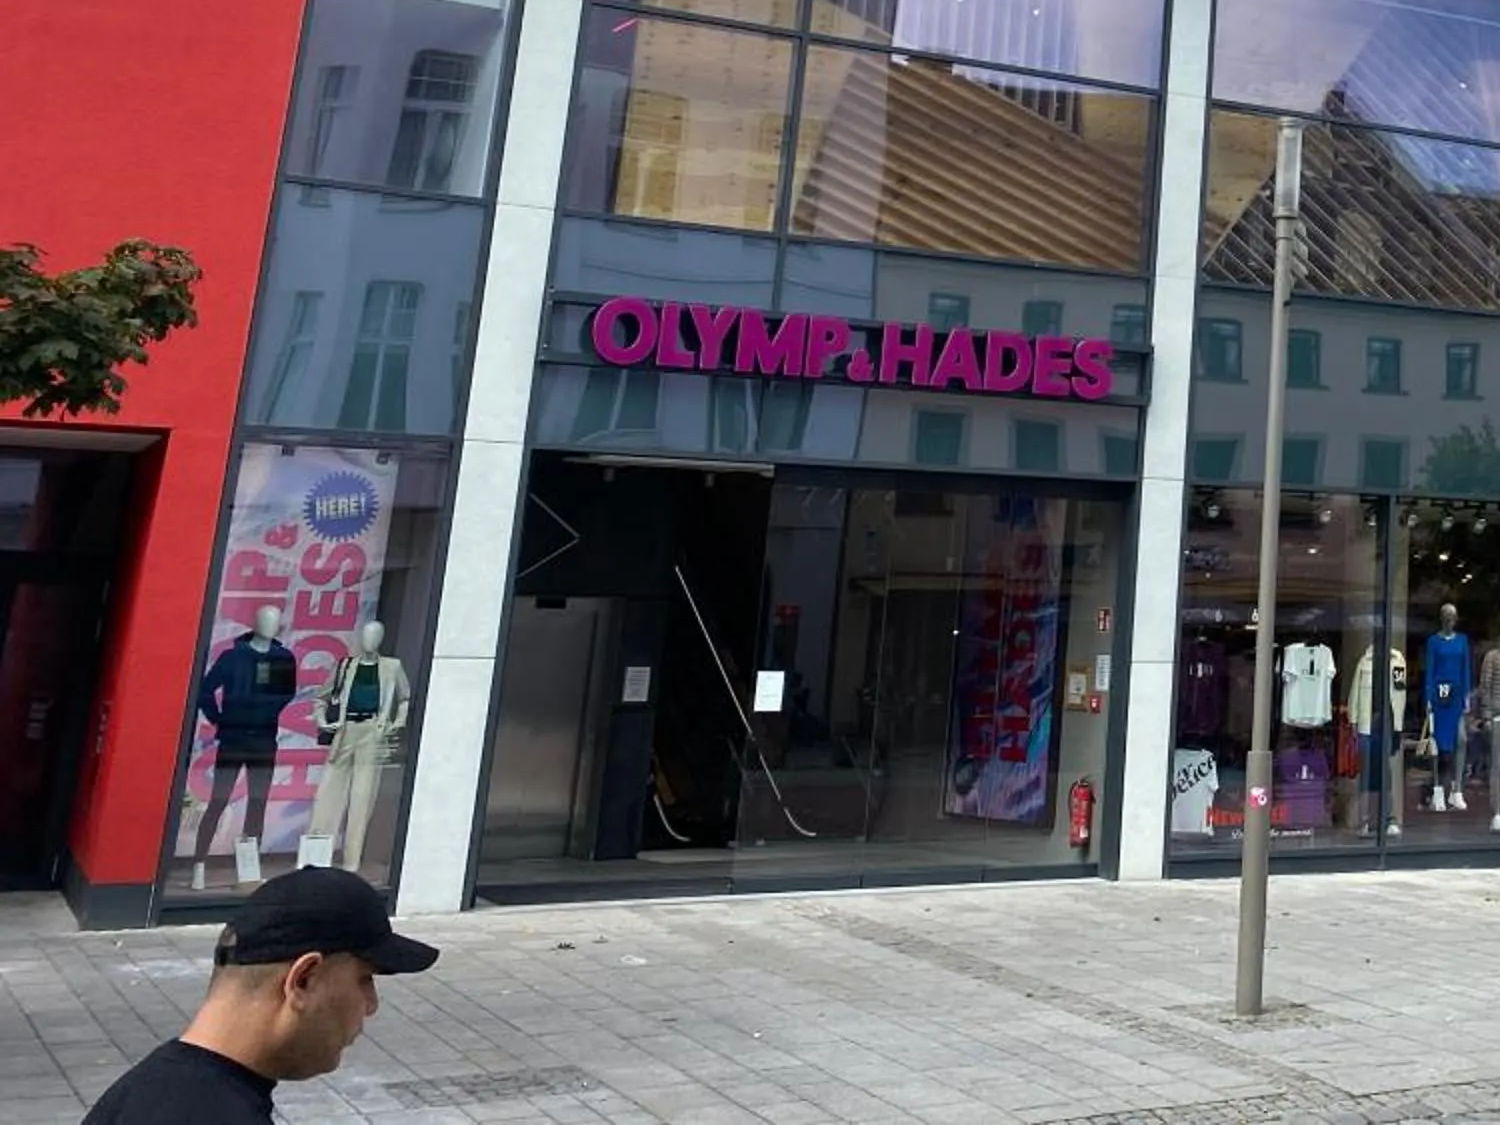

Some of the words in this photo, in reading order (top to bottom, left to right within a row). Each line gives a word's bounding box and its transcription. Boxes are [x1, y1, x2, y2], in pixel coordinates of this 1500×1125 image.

[591, 295, 851, 378] OLYMP
[878, 321, 1115, 400] HADES
[315, 494, 367, 521] HERE!
